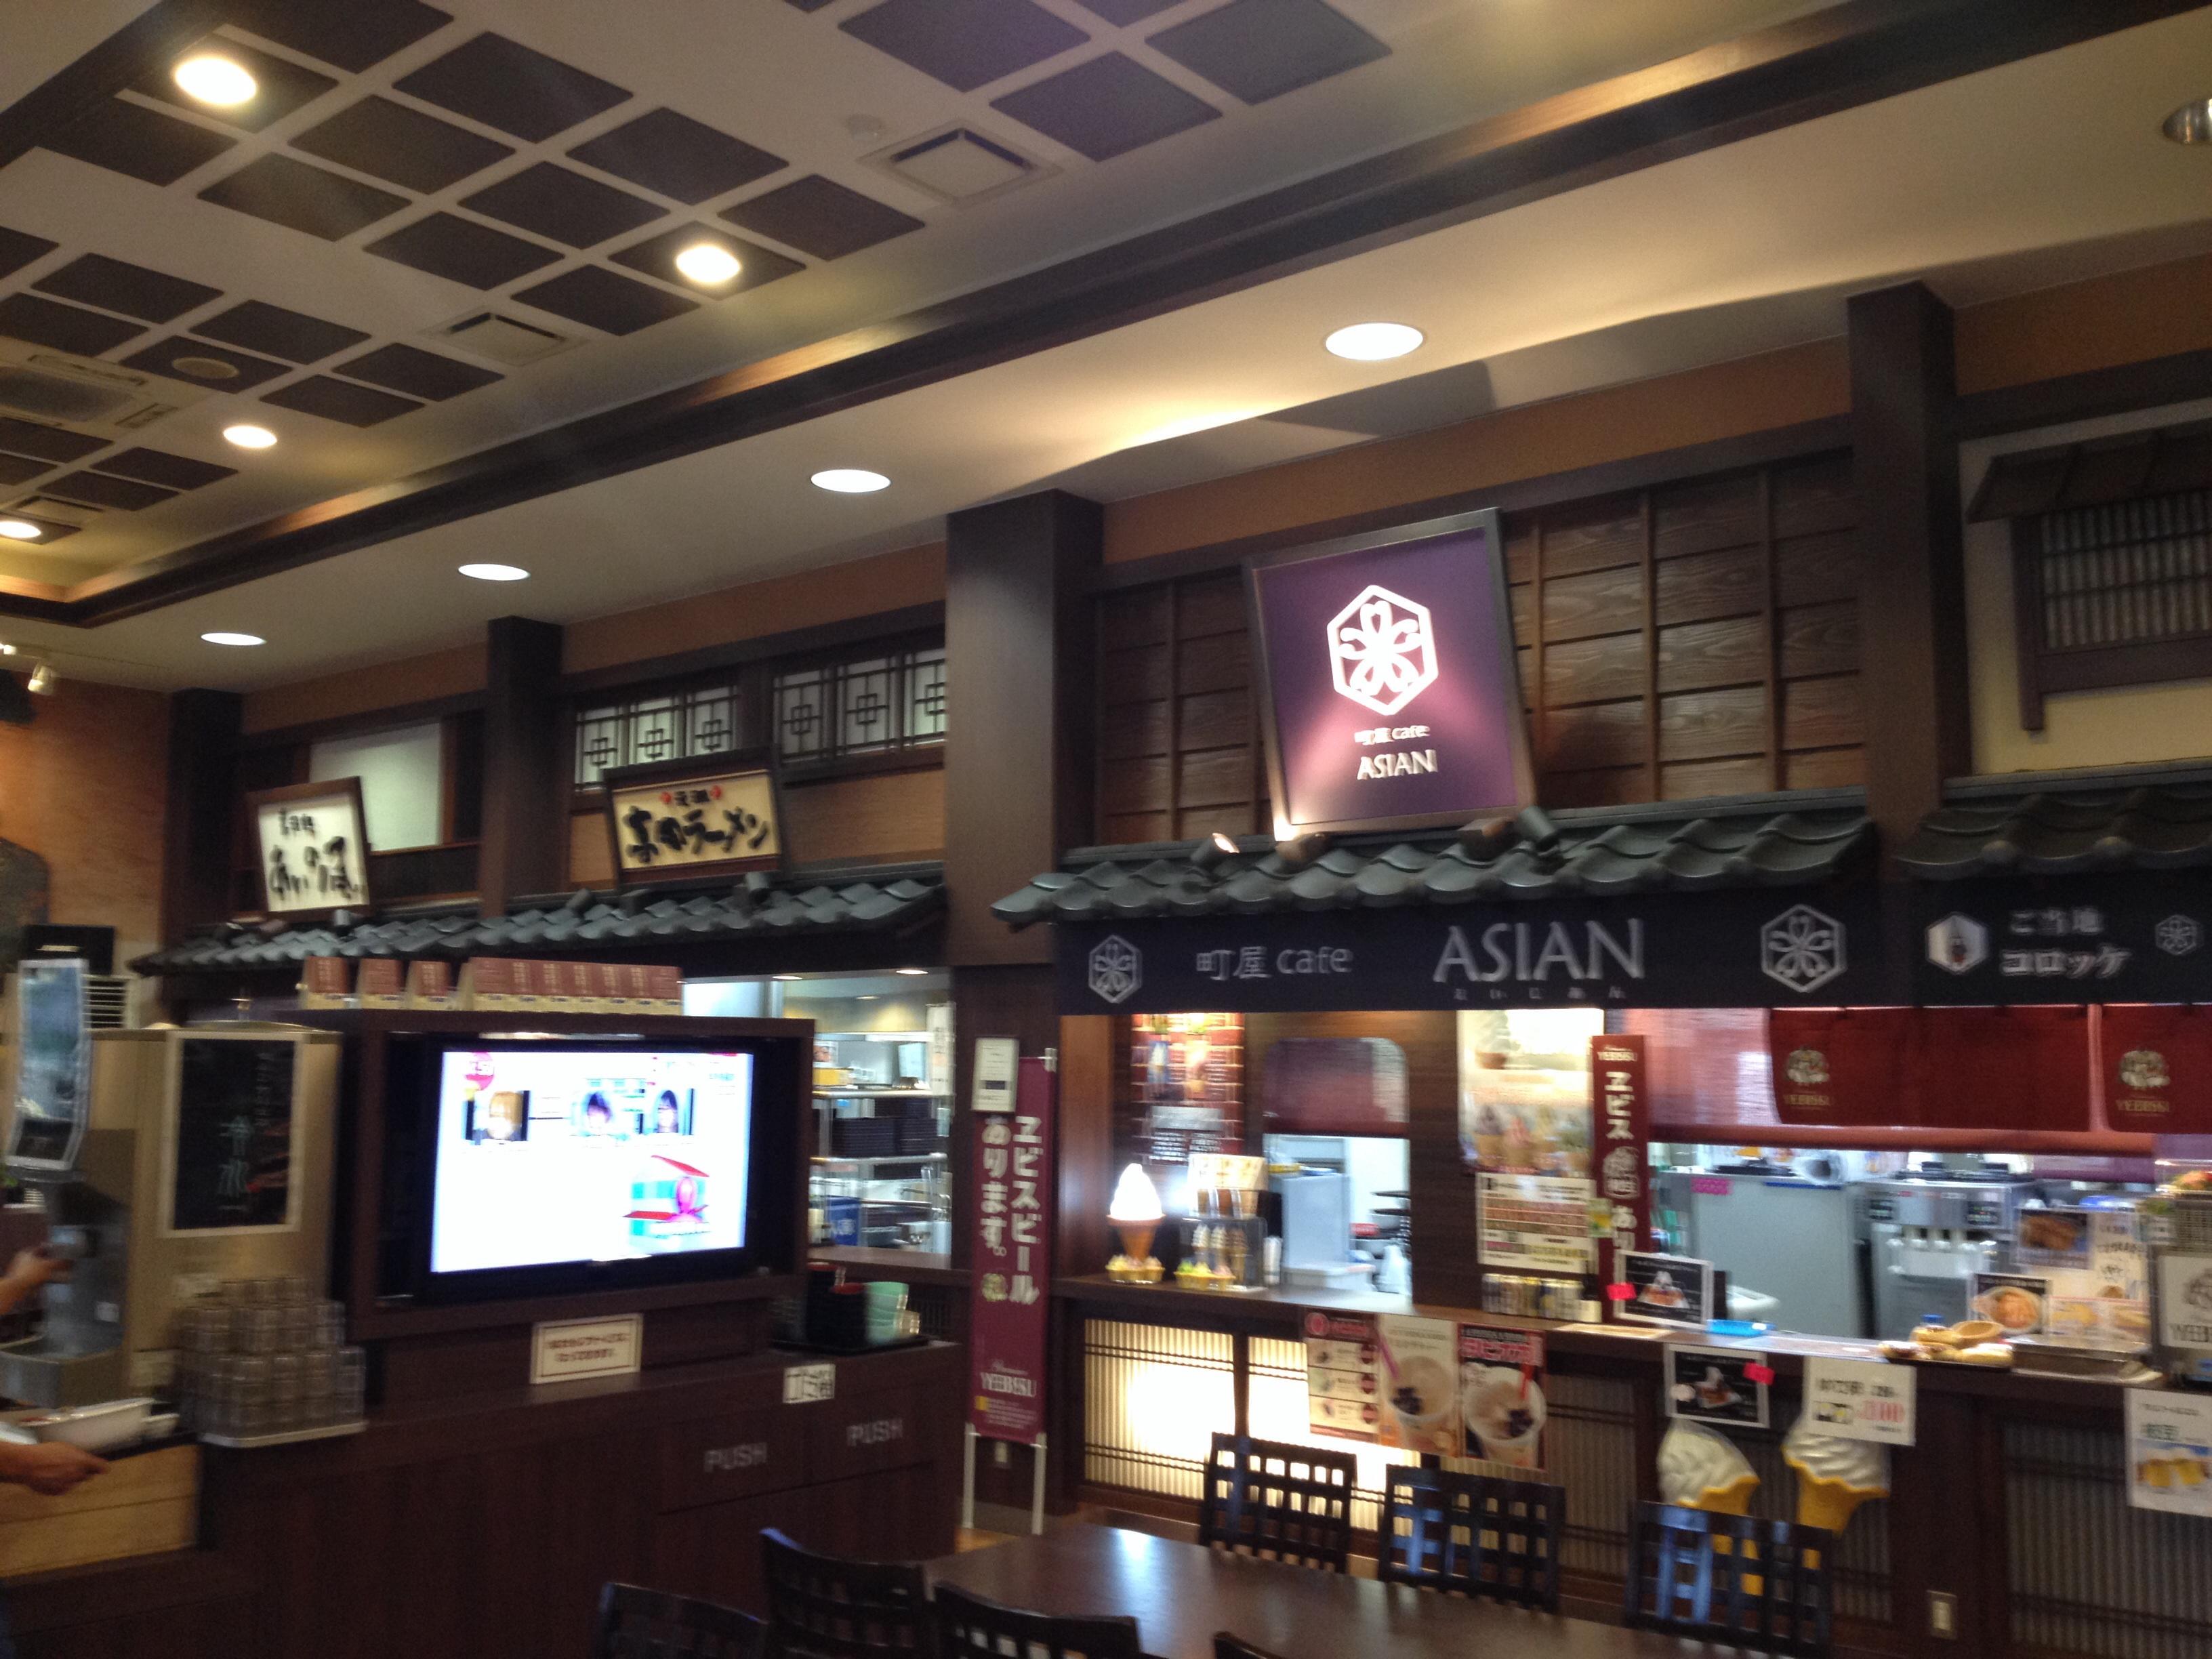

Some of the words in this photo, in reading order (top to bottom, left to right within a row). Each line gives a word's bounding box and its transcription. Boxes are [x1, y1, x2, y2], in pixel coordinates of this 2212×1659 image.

[1357, 749, 1437, 780] ASIAN
[1195, 945, 1271, 981] 町屋
[1275, 945, 1353, 975] cafe
[1433, 918, 1647, 983] ASIAN
[1999, 941, 2132, 979] コロッケ
[1605, 1071, 1635, 1140] エビス
[1009, 1116, 1044, 1305] エビスビール
[847, 1419, 903, 1446] PUSH
[704, 1443, 766, 1471] PUSH
